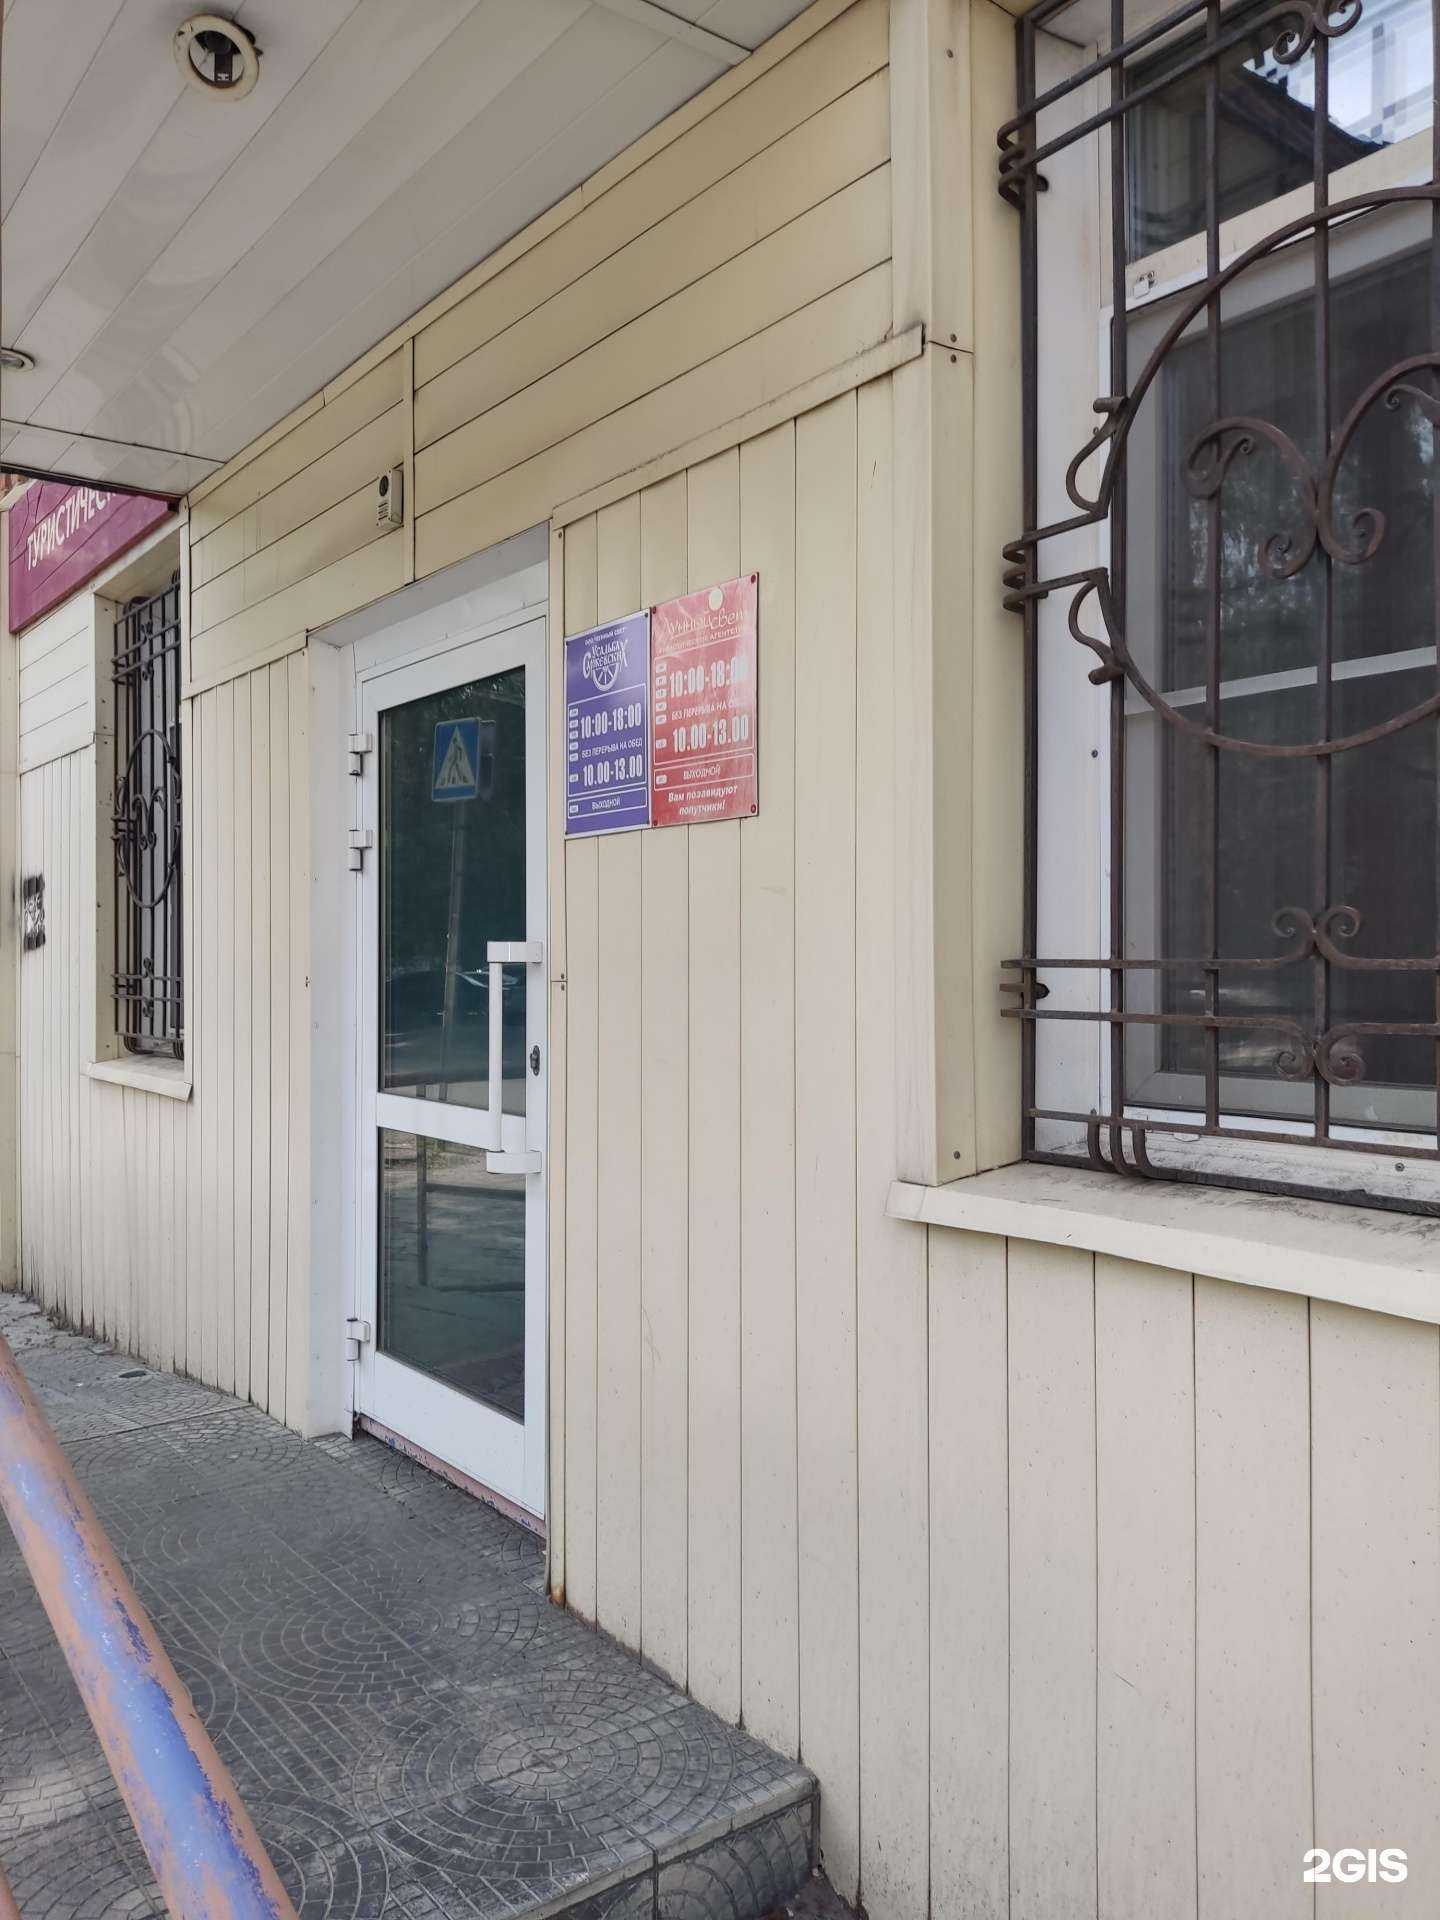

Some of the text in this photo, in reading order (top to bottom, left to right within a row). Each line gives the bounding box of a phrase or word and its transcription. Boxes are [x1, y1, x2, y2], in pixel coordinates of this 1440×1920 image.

[581, 702, 642, 739] 10:00-18:00
[672, 714, 749, 753] 10.00-13.00
[620, 740, 628, 750] НА
[583, 754, 643, 786] 10.00-13.00
[668, 791, 685, 803] Вам
